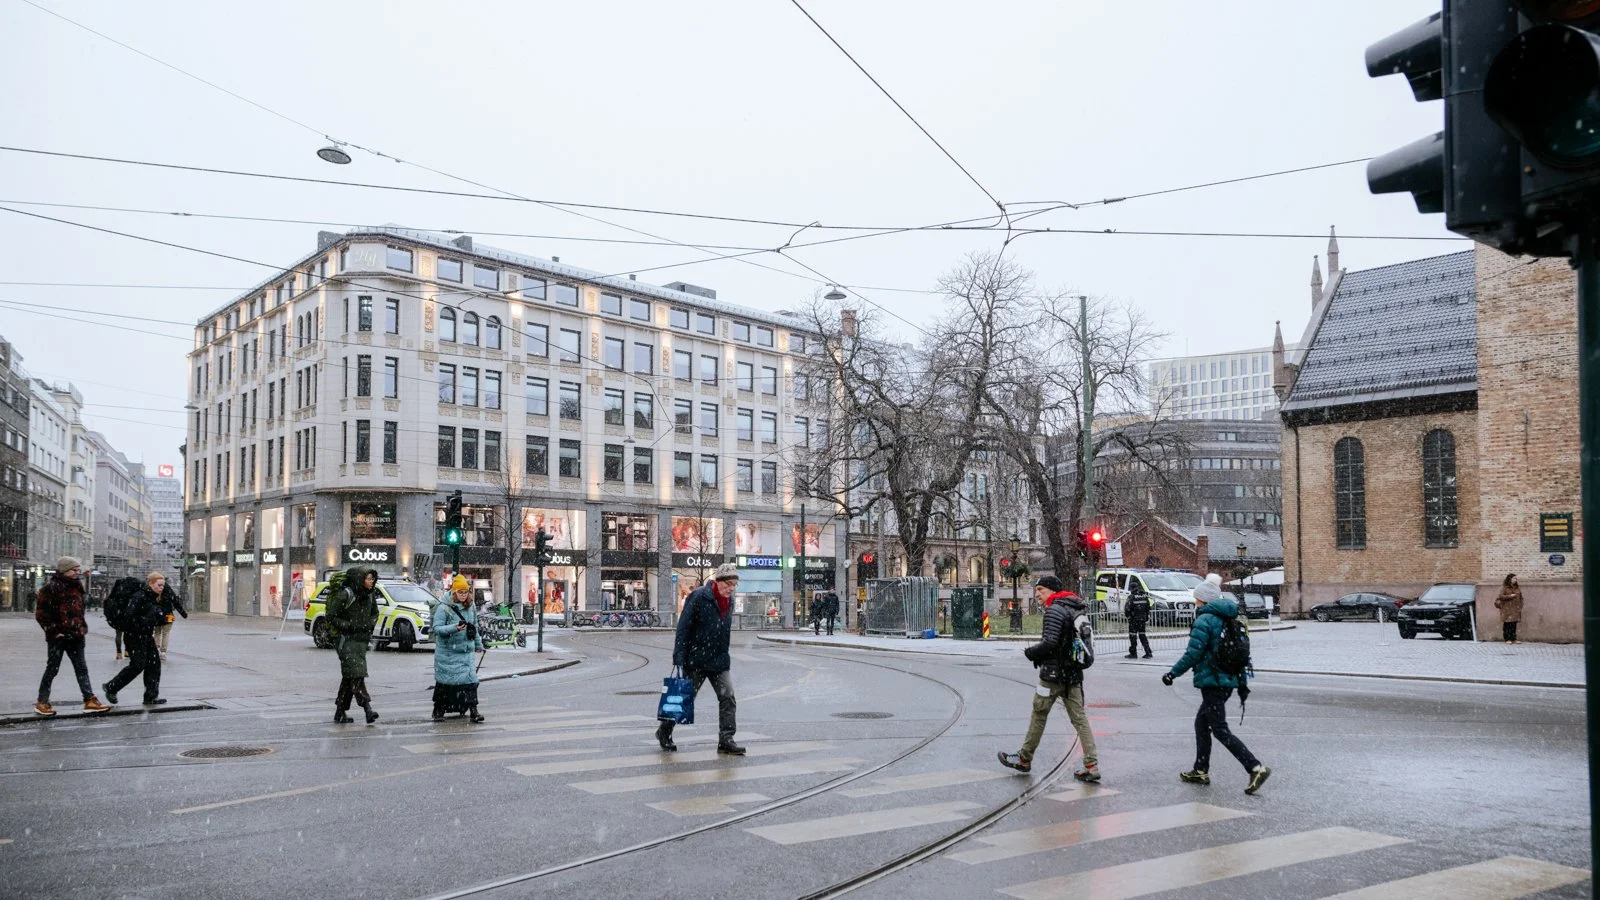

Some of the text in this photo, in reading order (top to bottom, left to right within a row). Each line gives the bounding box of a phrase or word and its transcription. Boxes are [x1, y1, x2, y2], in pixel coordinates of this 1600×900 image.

[263, 551, 277, 563] Cubus
[349, 548, 388, 561] Cubus
[747, 558, 777, 567] APOTEK
